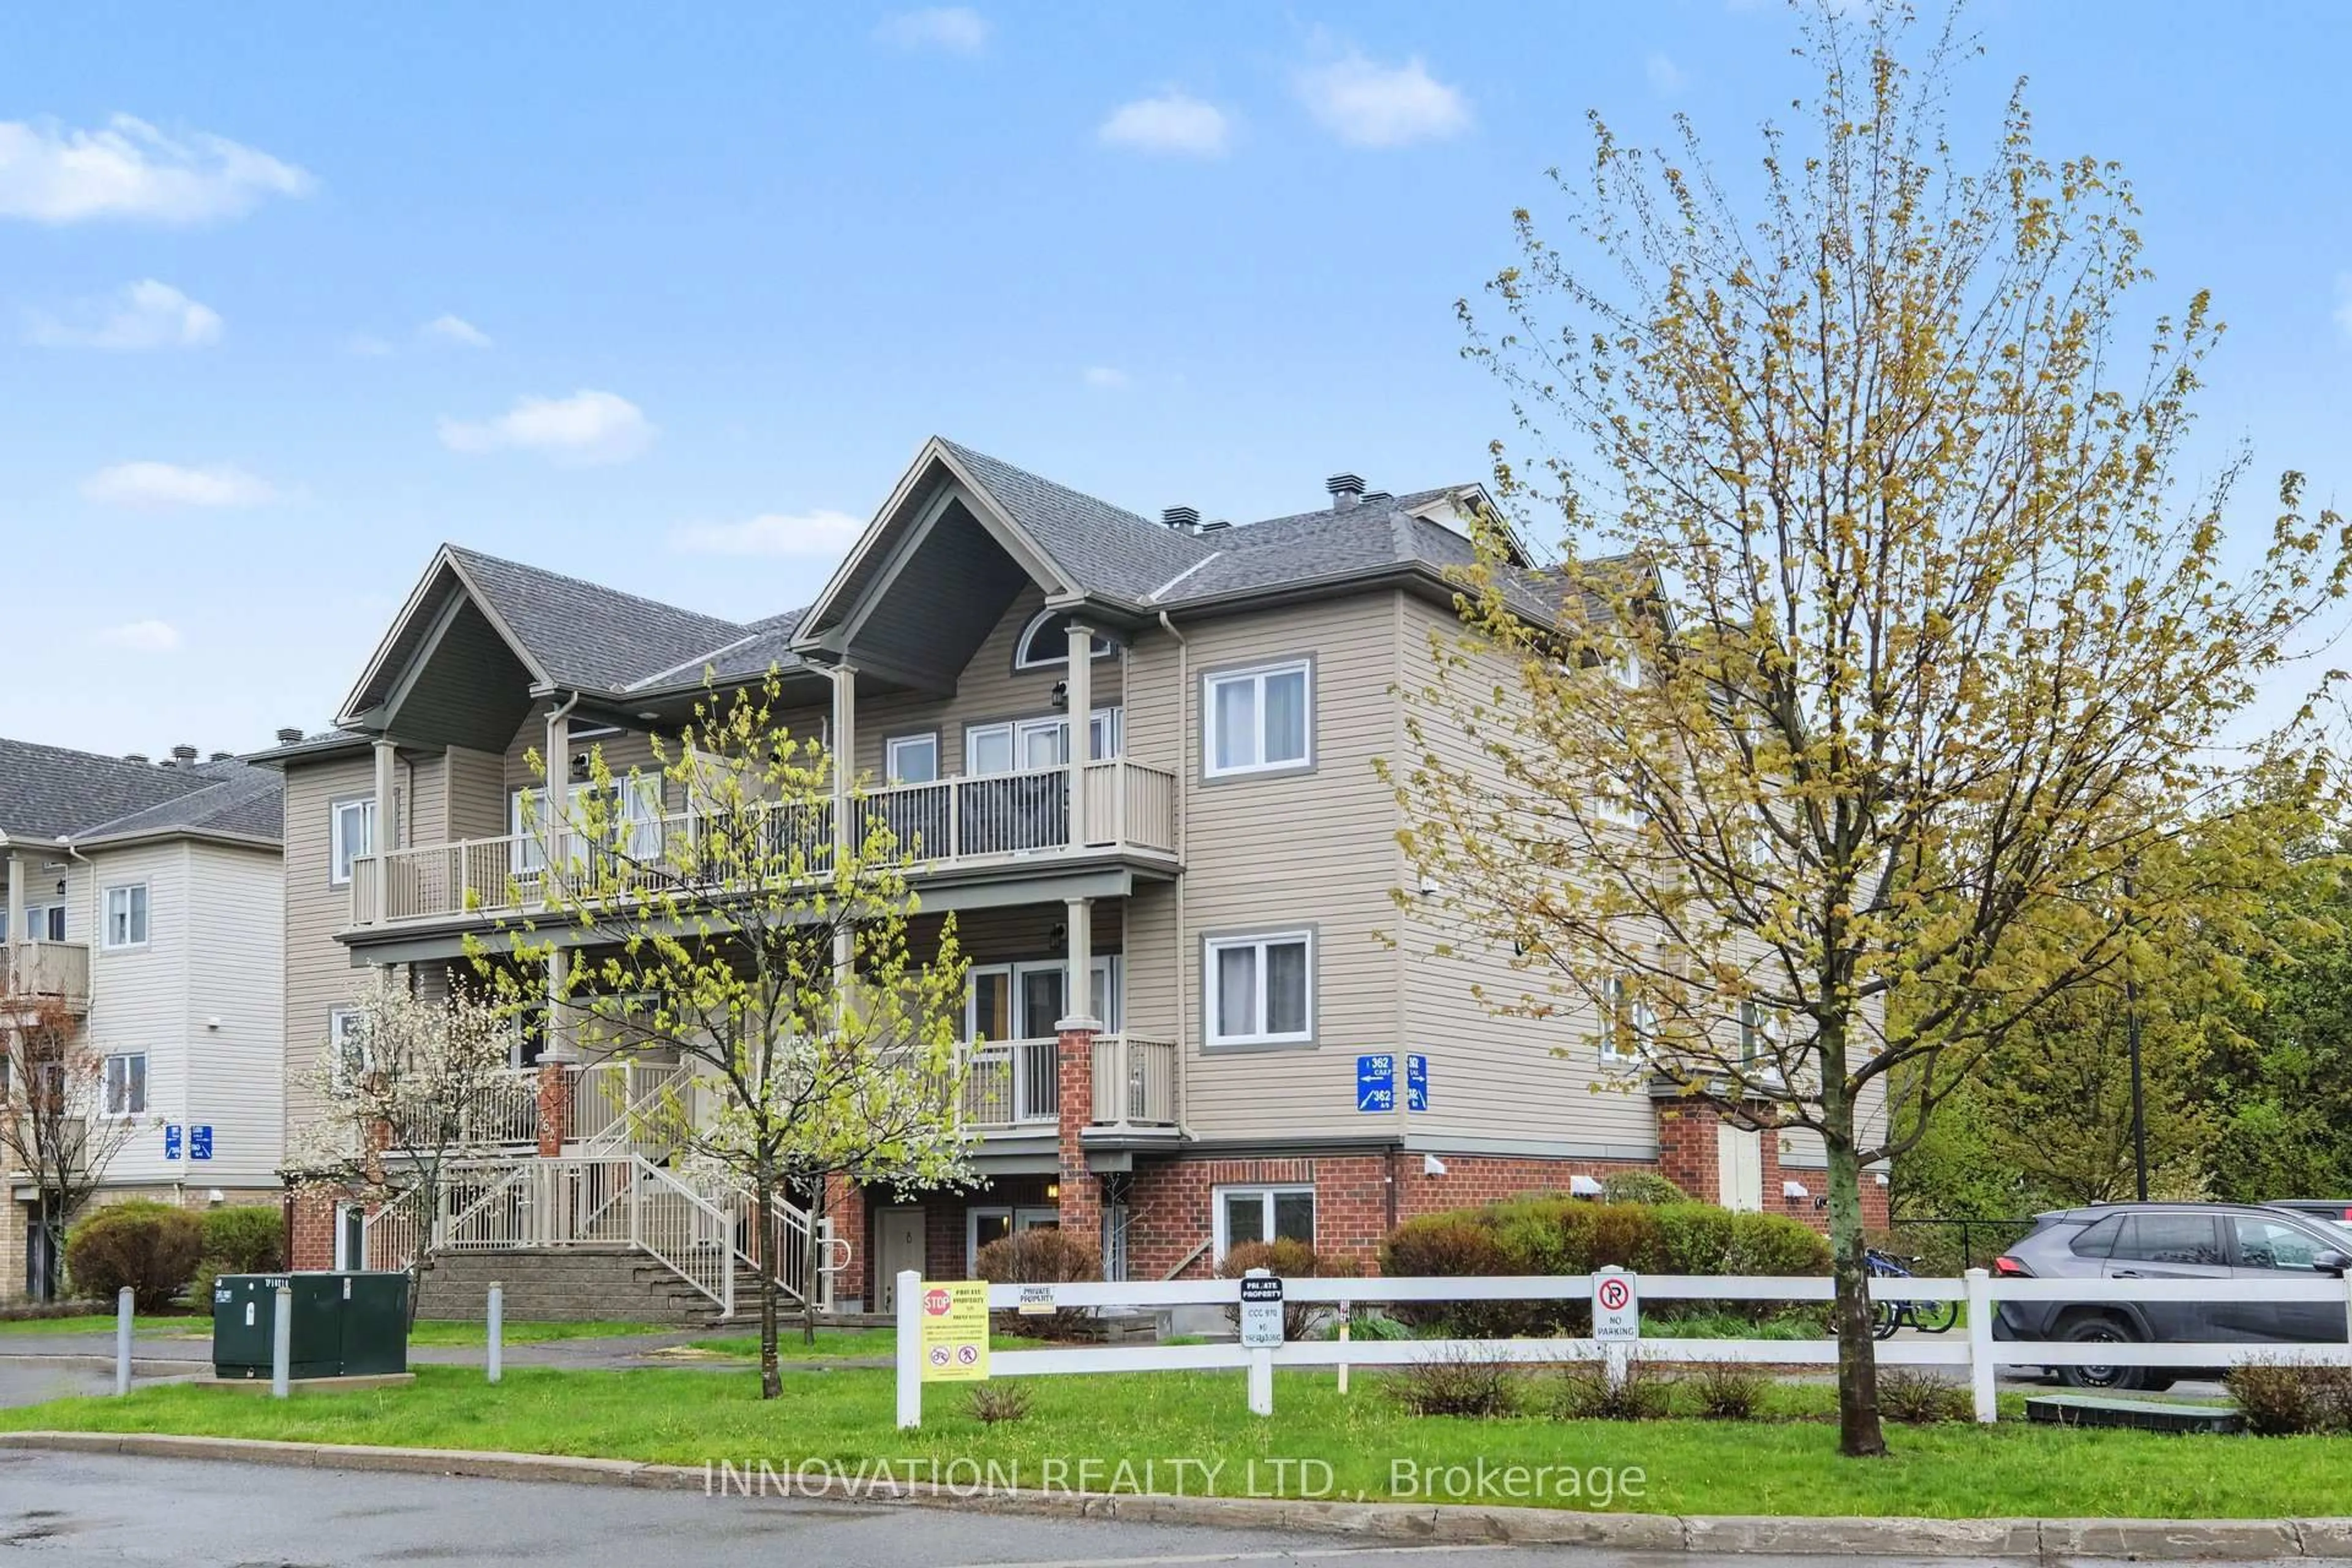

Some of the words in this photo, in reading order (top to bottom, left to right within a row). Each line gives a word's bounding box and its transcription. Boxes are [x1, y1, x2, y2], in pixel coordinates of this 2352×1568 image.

[1371, 1057, 1389, 1069] 362
[1373, 1090, 1391, 1102] 362
[924, 1295, 949, 1310] STOP
[1609, 1316, 1622, 1325] NO
[1597, 1327, 1634, 1336] PARKING
